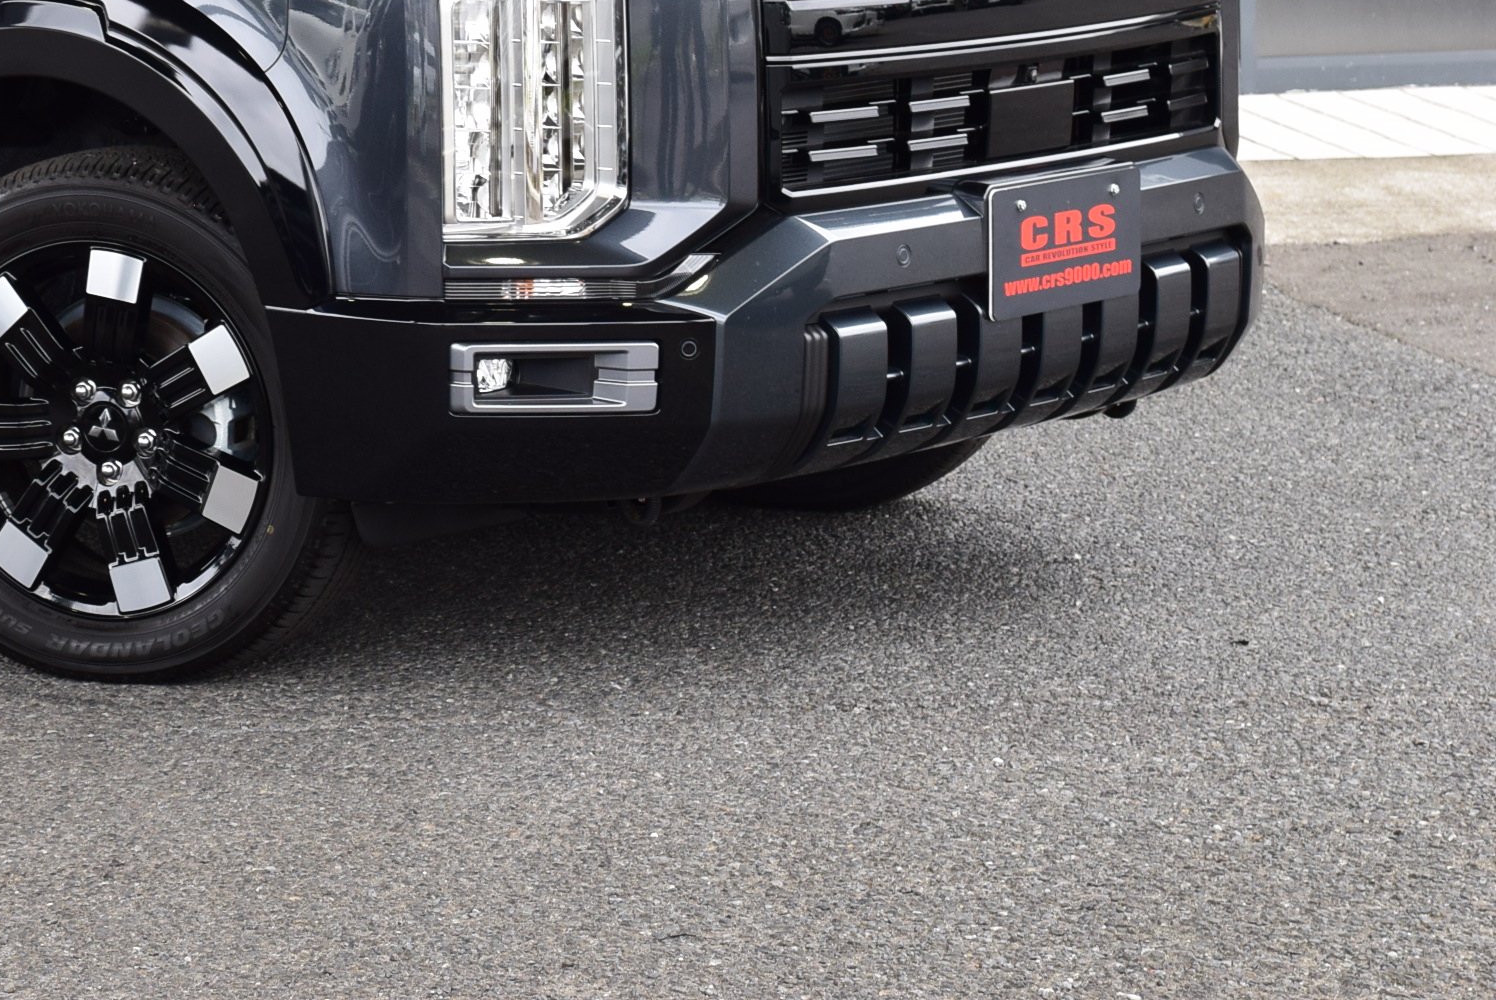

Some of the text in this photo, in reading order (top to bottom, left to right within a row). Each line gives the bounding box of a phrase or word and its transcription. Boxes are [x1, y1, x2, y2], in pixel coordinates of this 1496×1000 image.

[51, 201, 156, 227] YOKOHAMA
[1021, 204, 1116, 250] CRS
[1025, 241, 1112, 264] CAR REVOLUTION STYLE
[1004, 259, 1132, 297] www.crs9000.com
[45, 608, 225, 657] GEOLANDAR
